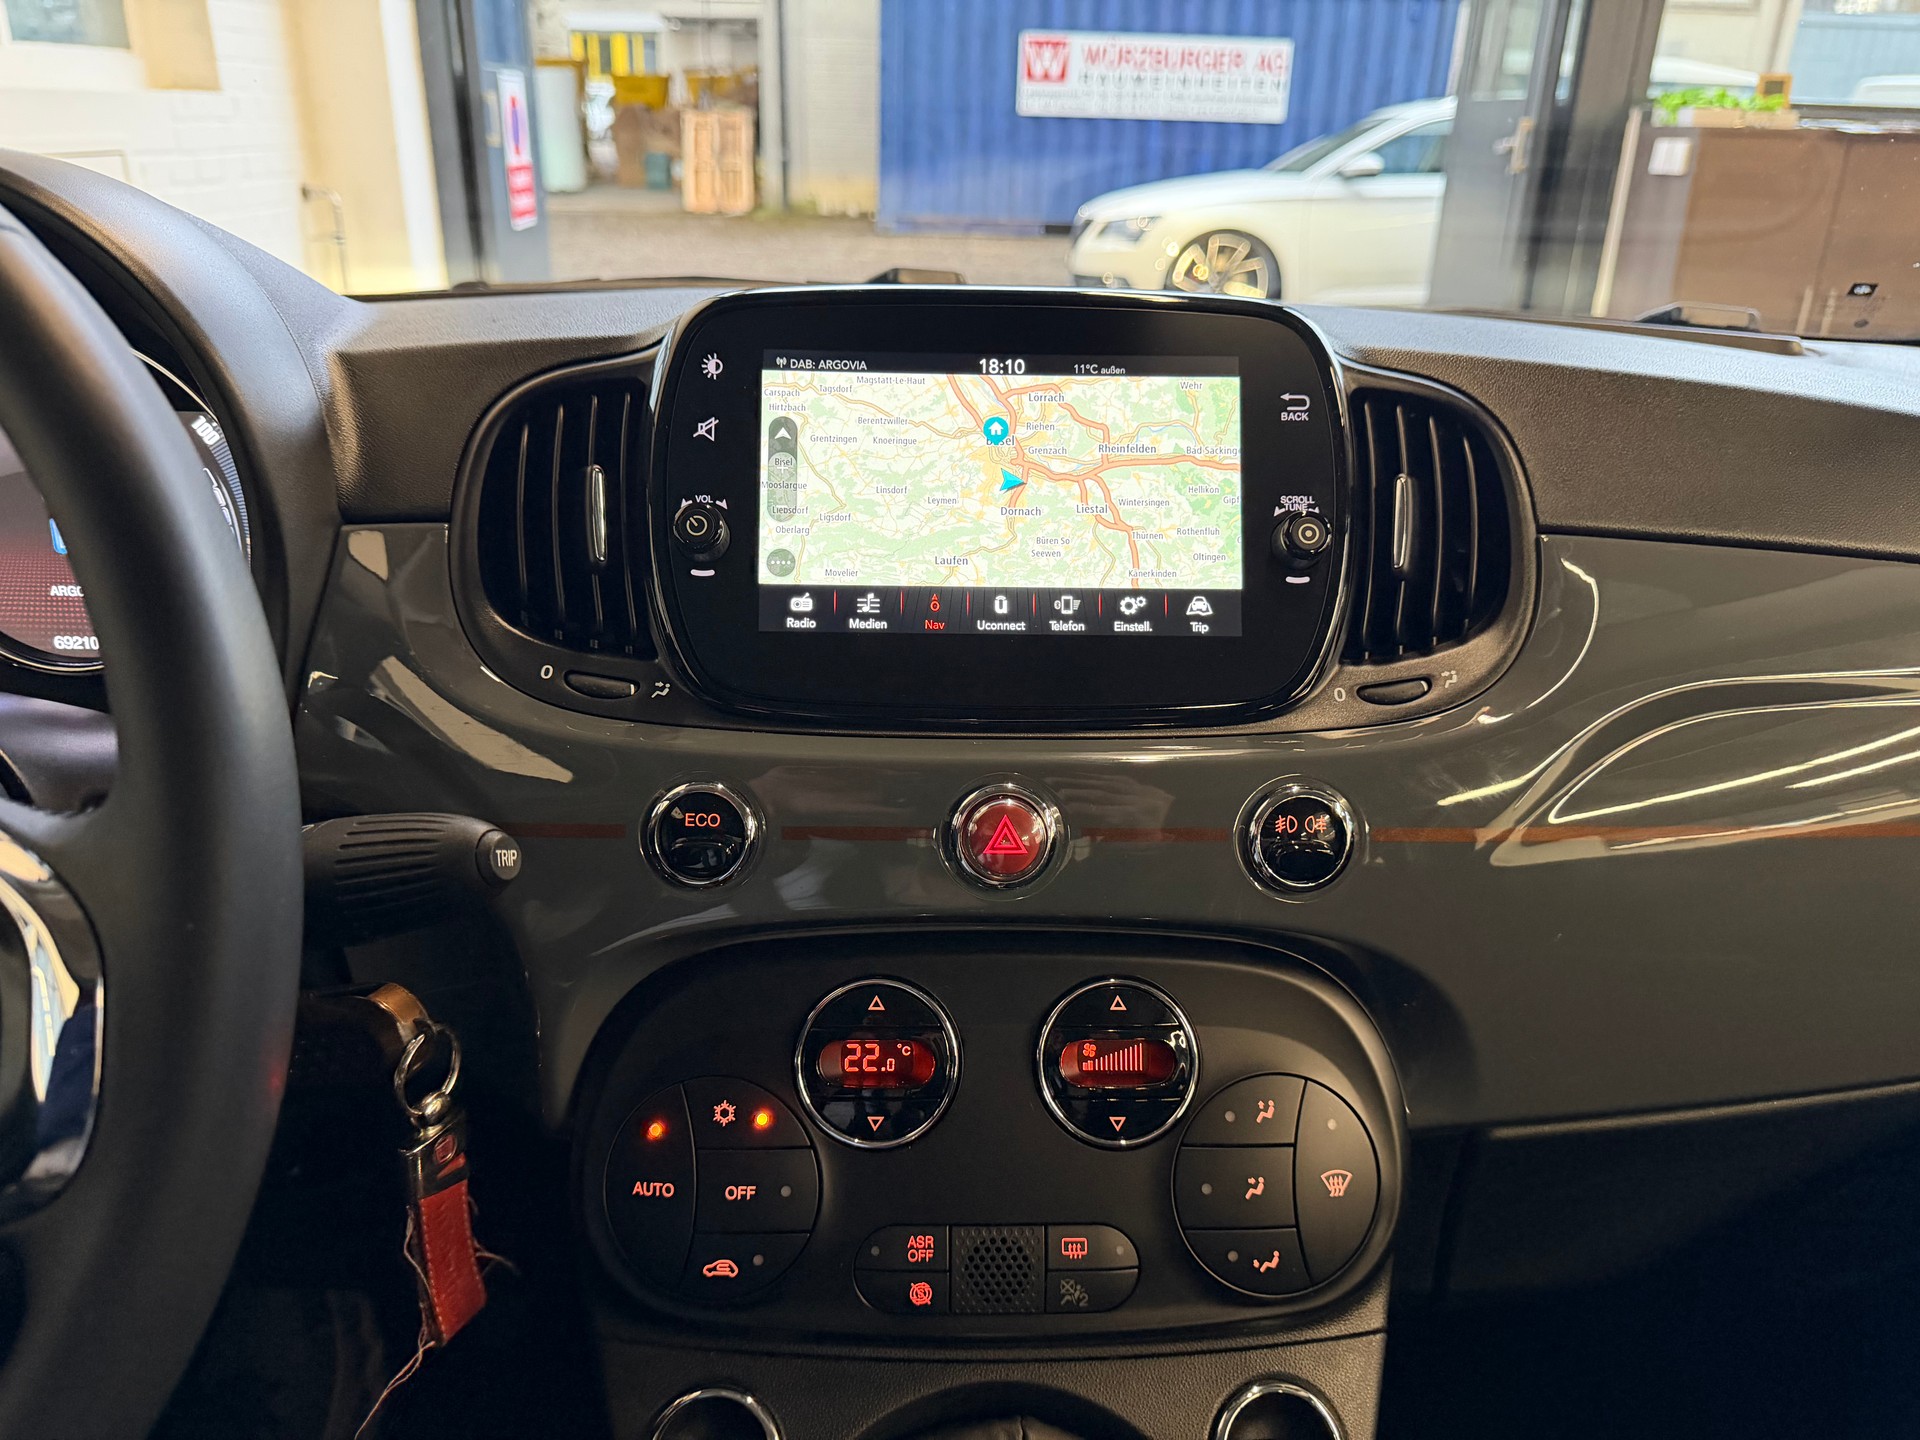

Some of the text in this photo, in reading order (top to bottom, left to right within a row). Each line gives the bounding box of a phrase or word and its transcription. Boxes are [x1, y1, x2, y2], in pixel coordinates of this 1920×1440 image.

[790, 359, 867, 370] DAB: ARGOVIA
[979, 358, 1025, 375] 18:10
[1074, 364, 1126, 374] 11°C außen
[819, 385, 852, 394] Tagsdorf
[1180, 381, 1203, 390] Wehr
[764, 389, 800, 398] Carspach
[1028, 393, 1065, 402] Lörrach
[769, 403, 806, 412] Hirtzbach
[858, 417, 908, 425] Berentzwiller
[1281, 412, 1309, 421] BACK
[191, 415, 220, 446] 100
[1026, 422, 1055, 431] Riehen
[811, 435, 857, 443] Grentzingen
[873, 437, 917, 446] Knoeringue
[986, 435, 1015, 446] Bsel
[1028, 446, 1067, 455] Grenzach
[1098, 444, 1156, 454] Rheinfelden
[1186, 446, 1202, 455] Bad
[774, 458, 793, 466] Bisel
[876, 486, 908, 494] Linsdorf
[1188, 486, 1219, 494] Hellikon
[695, 494, 713, 503] VOL
[928, 497, 957, 505] Leymen
[1118, 498, 1169, 507] Wintersingen
[1000, 507, 1041, 516] Dornach
[1076, 504, 1108, 513] Liestal
[819, 513, 851, 522] Ligsdorf
[776, 526, 810, 535] Oberlarg
[1036, 537, 1070, 545] Büren So
[934, 556, 968, 565] Laufen
[1193, 553, 1226, 562] Oltingen
[825, 569, 858, 577] Movelier
[787, 618, 816, 628] Radio
[849, 619, 887, 629] Medien
[925, 620, 945, 630] Nav
[977, 620, 1026, 631] Uconnect
[1049, 622, 1085, 631] Telefon
[1114, 622, 1152, 632] Einstell.
[1190, 622, 1209, 633] Trip
[53, 636, 100, 650] 69210
[684, 813, 721, 827] ECO
[496, 850, 517, 867] TRIP
[632, 1182, 675, 1197] AUTO
[725, 1186, 756, 1200] OFF
[907, 1235, 934, 1249] ASR
[907, 1249, 934, 1263] OFF
